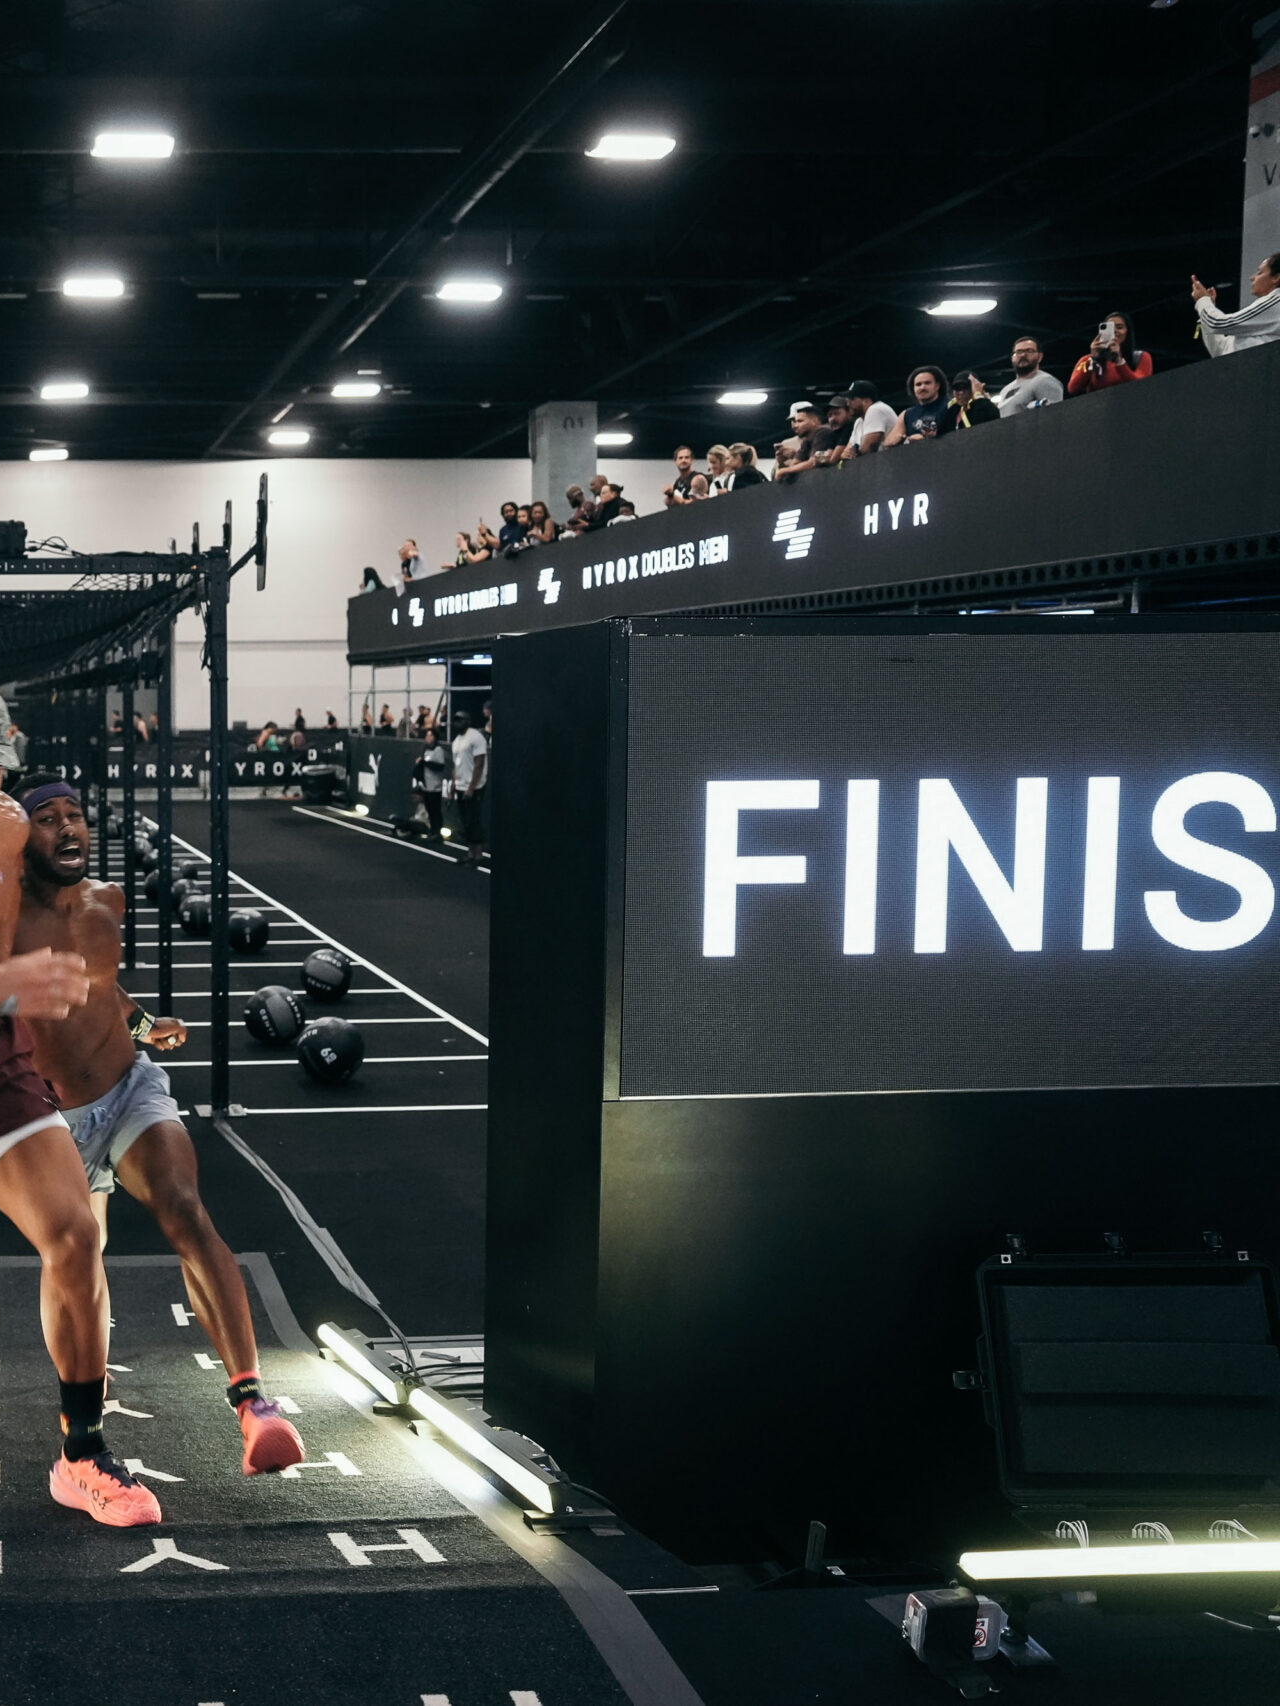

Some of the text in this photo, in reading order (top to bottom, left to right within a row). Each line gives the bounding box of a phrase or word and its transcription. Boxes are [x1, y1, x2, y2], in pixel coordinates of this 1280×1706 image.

[863, 492, 929, 536] HYR
[582, 534, 729, 590] HYROX DOUBLES MEN
[107, 764, 194, 779] HRX
[234, 761, 303, 777] YROX
[702, 771, 1277, 957] FINIS
